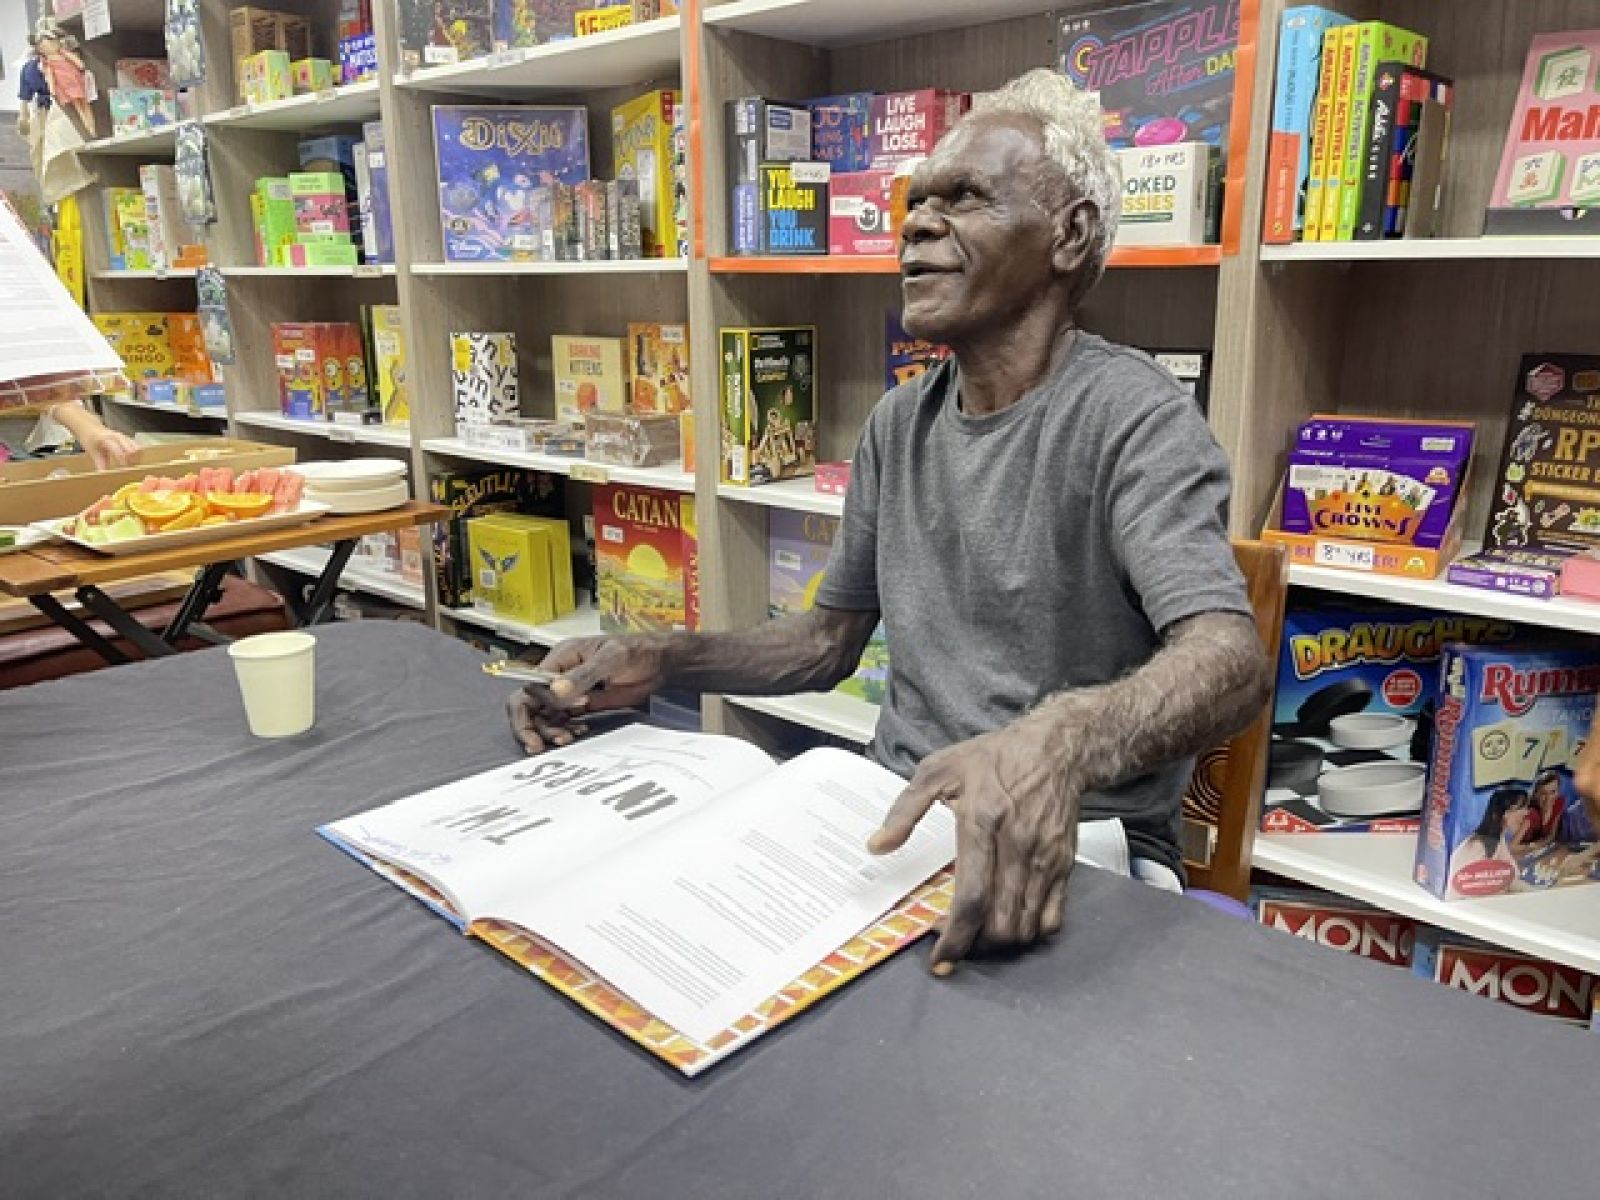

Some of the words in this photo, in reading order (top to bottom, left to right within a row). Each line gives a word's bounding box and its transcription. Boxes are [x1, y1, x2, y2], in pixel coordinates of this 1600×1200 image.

[886, 96, 916, 117] LIVE
[876, 112, 926, 135] LAUGH
[769, 189, 816, 210] LAUGH
[770, 229, 816, 246] DRINK
[612, 489, 680, 529] CATAN
